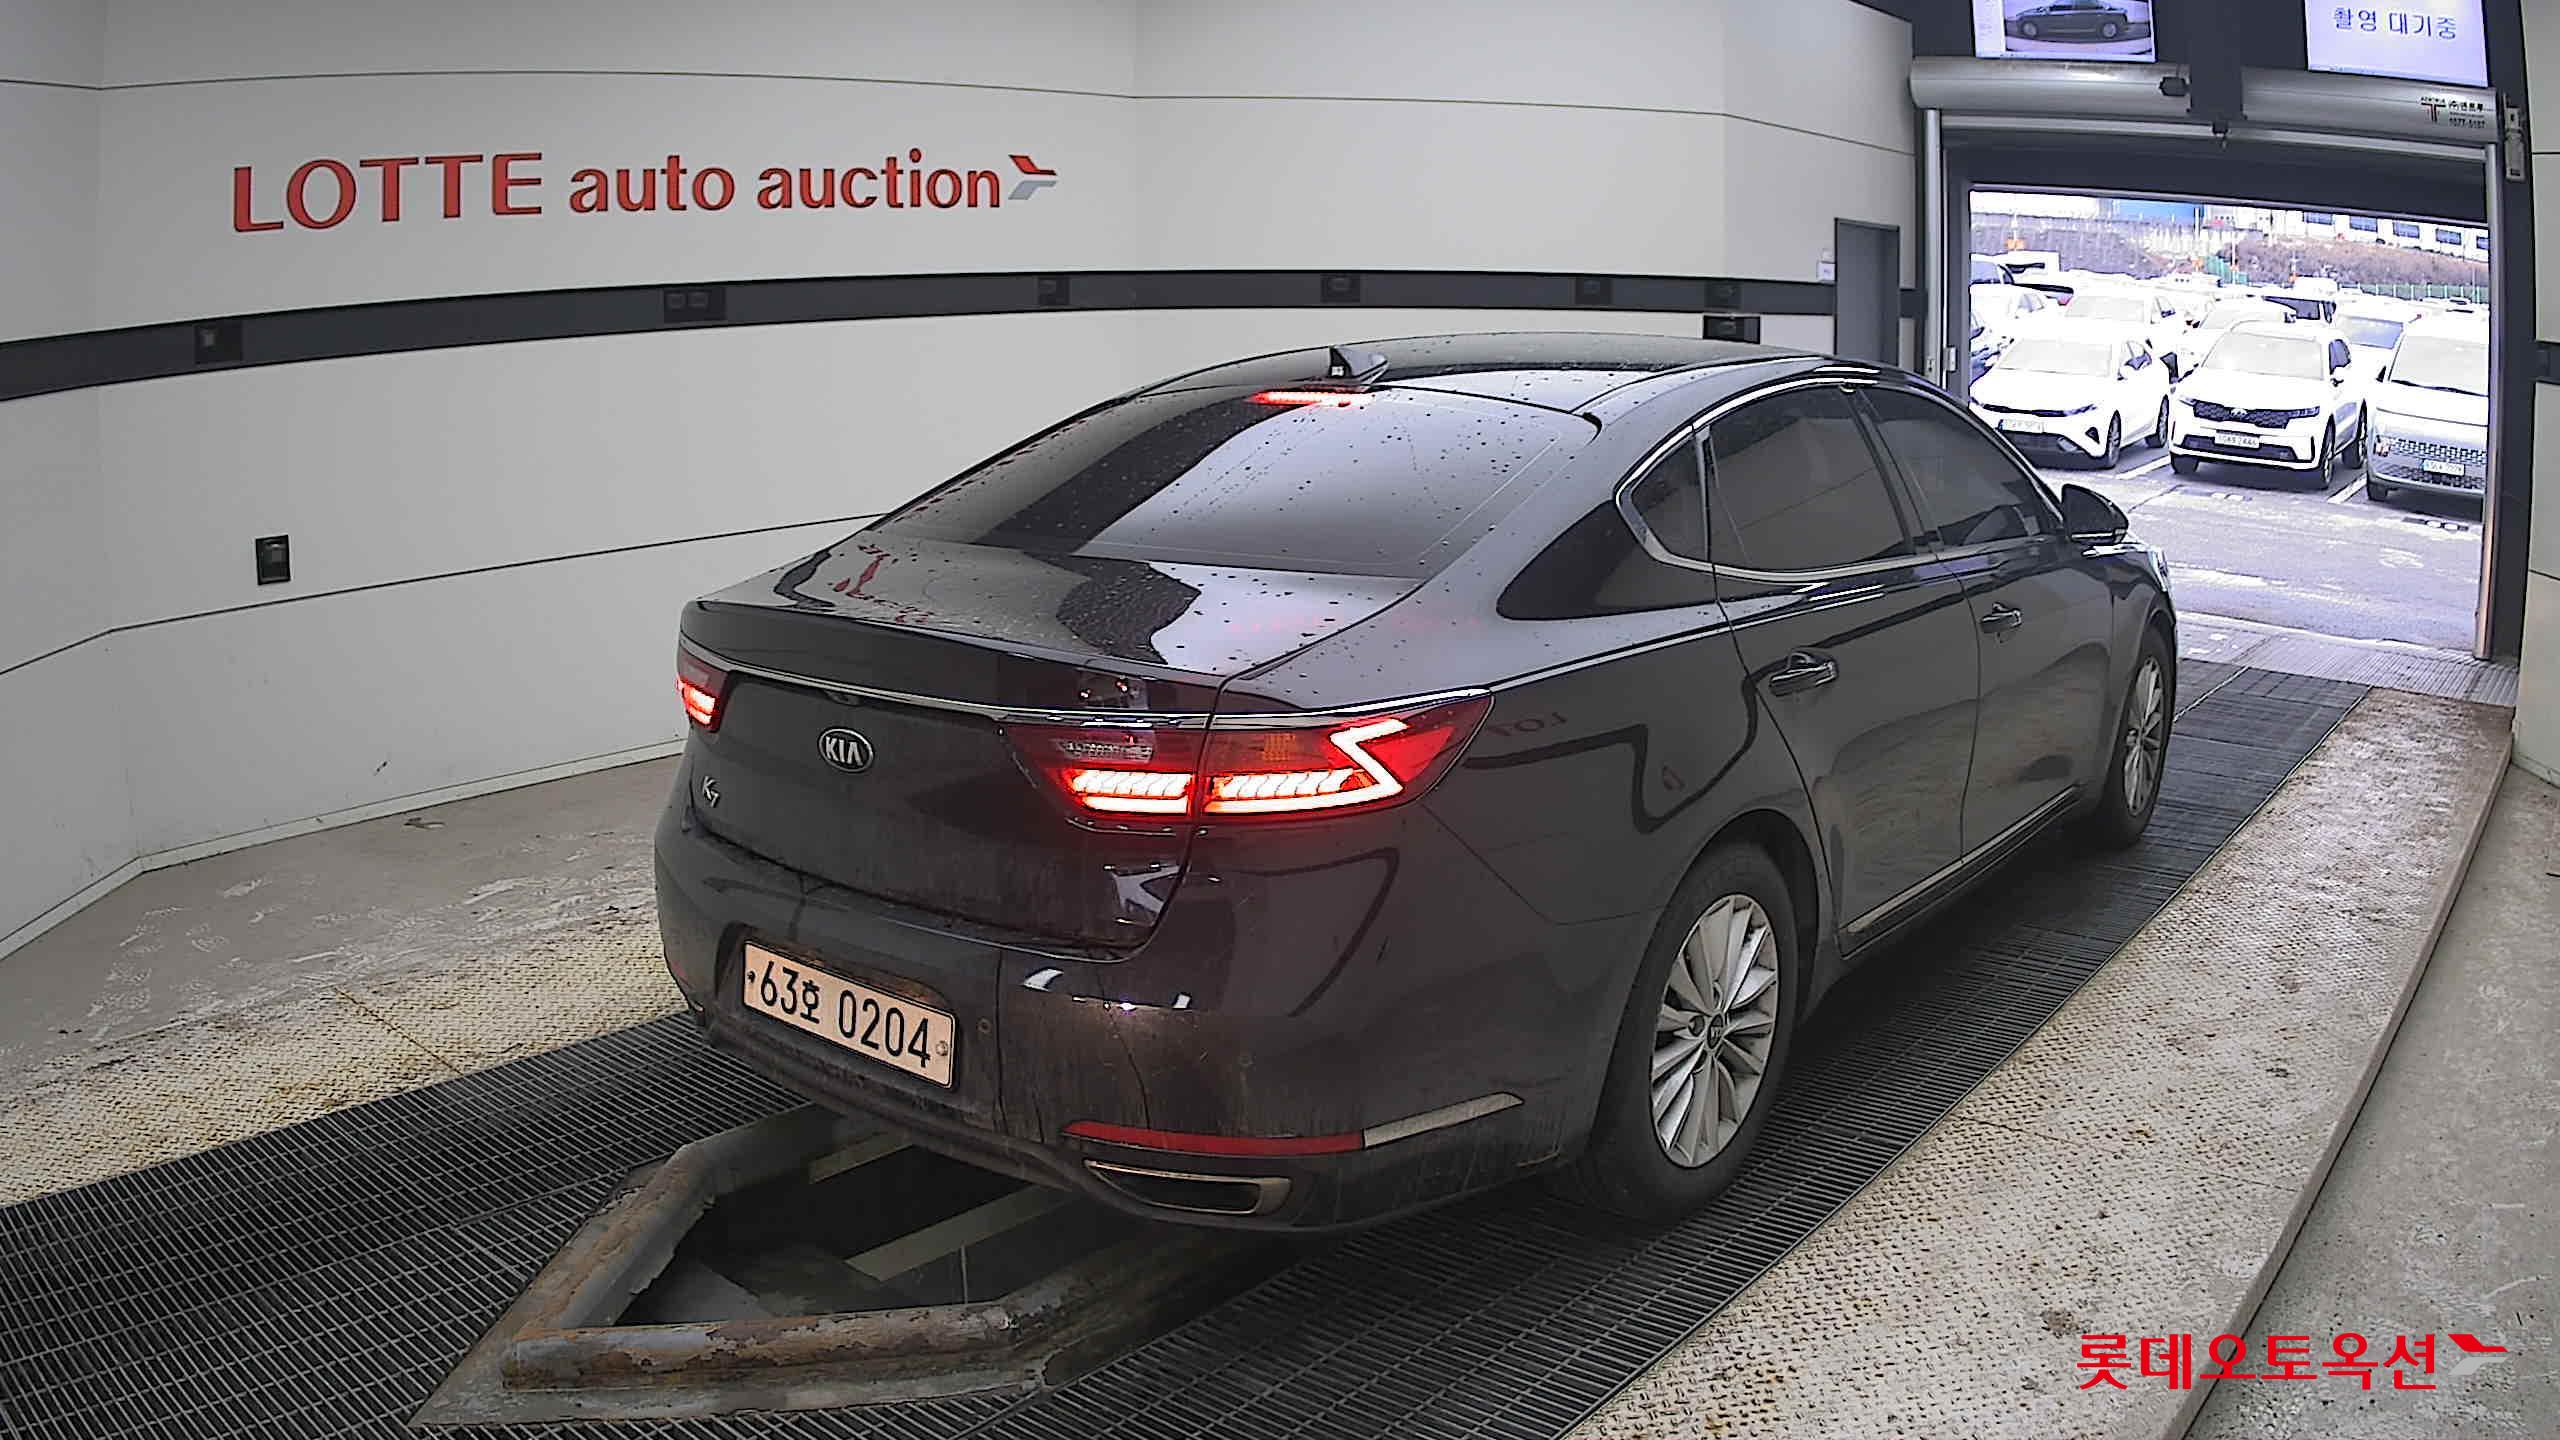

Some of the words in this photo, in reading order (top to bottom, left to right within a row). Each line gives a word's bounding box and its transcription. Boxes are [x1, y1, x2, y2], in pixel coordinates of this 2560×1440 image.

[2334, 7, 2378, 32] 촬영
[2388, 12, 2457, 40] 대기중
[233, 152, 543, 234] LOTTE
[568, 154, 736, 214] auto
[756, 147, 1001, 210] auction
[825, 735, 864, 766] KIA
[702, 775, 721, 808] K7
[760, 960, 820, 1024] 63호
[837, 989, 931, 1068] 0204
